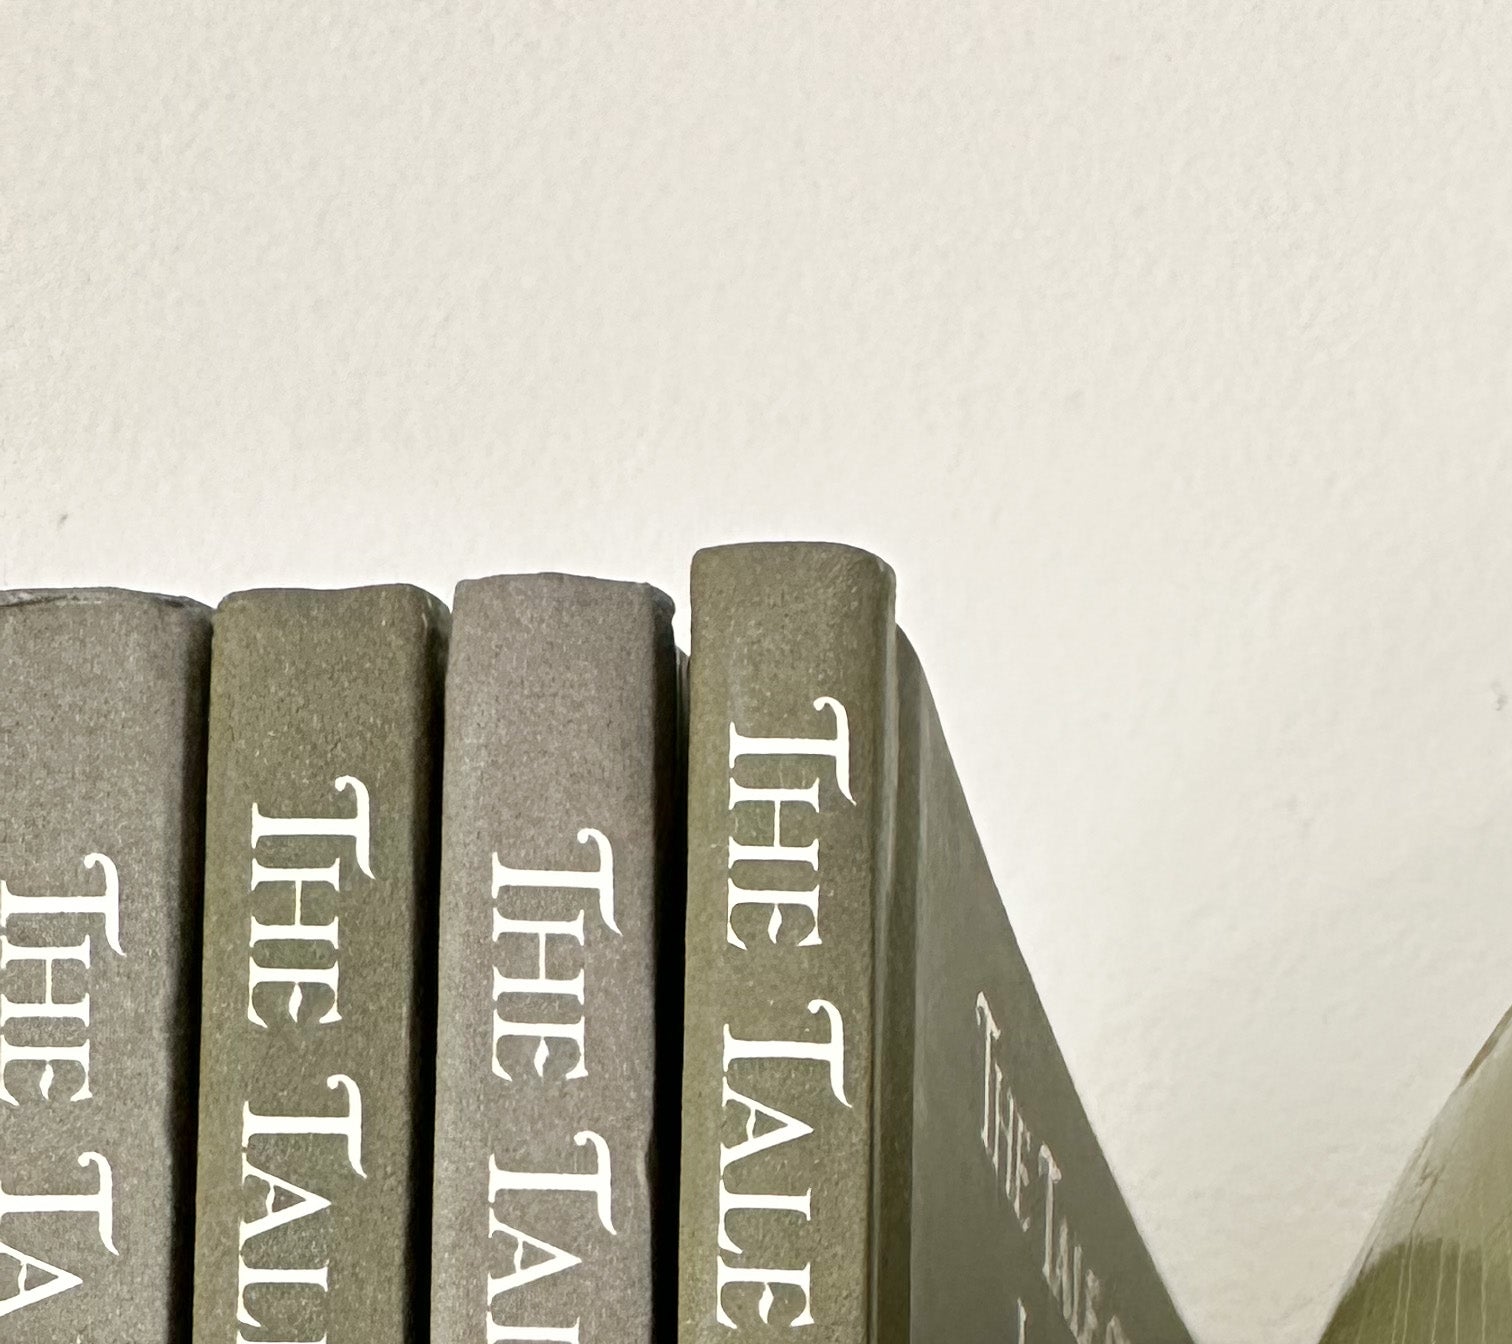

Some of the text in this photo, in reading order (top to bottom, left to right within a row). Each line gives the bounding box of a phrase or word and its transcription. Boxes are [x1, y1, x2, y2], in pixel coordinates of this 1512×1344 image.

[247, 775, 375, 1028] THE
[727, 697, 856, 950] THE
[0, 852, 127, 1106] THE
[491, 828, 623, 1082] THE
[716, 999, 852, 1329] TALE
[976, 991, 1031, 1232] THE
